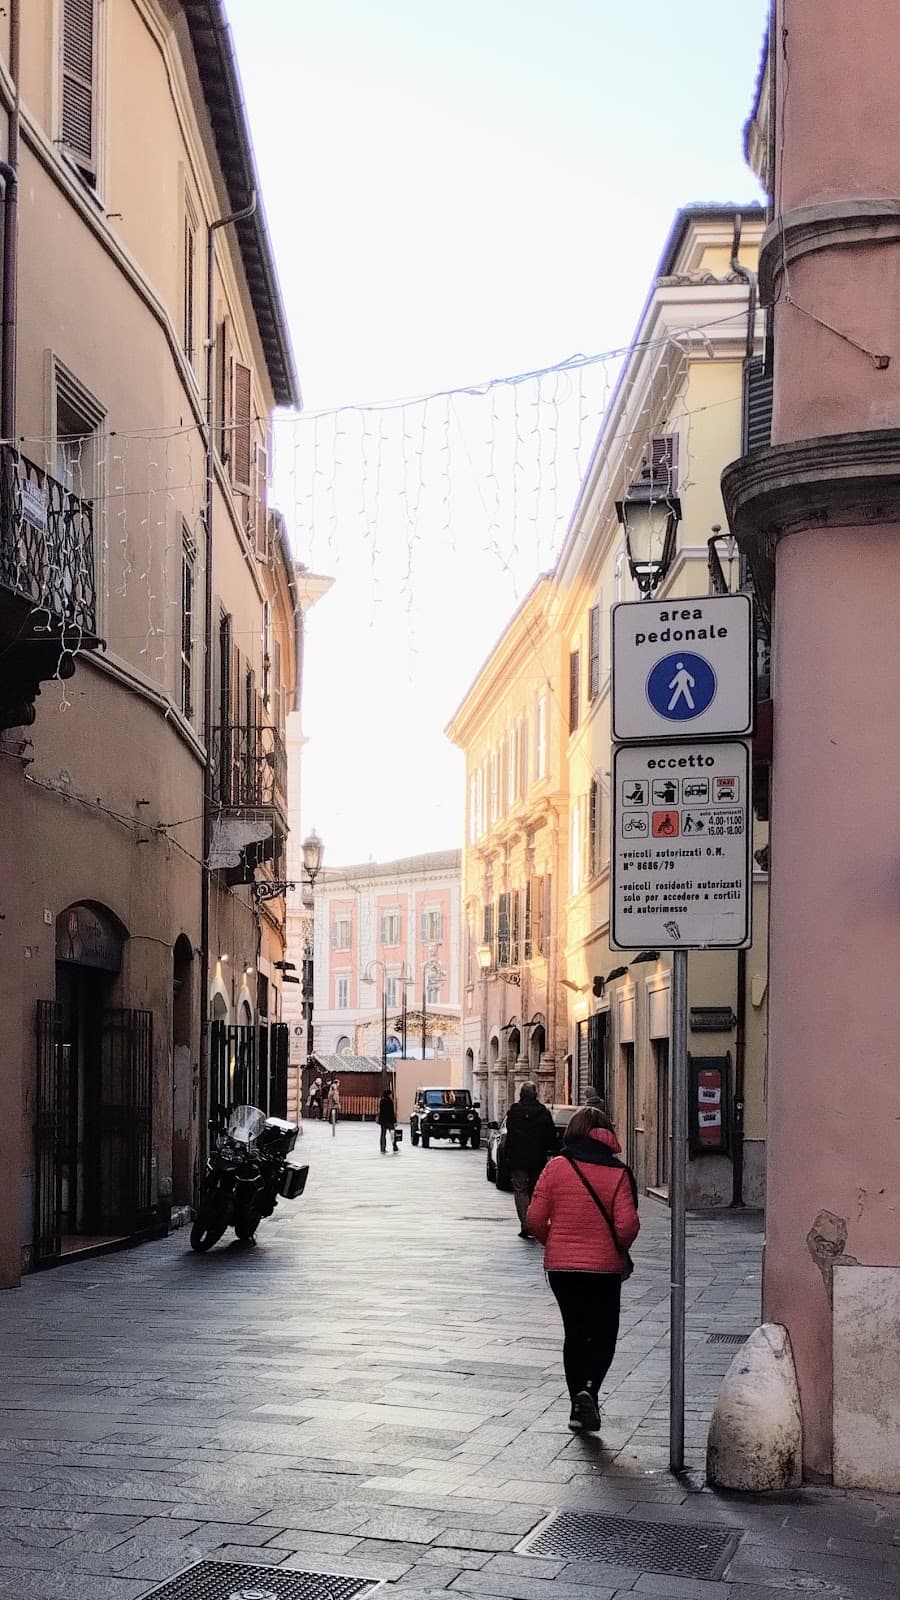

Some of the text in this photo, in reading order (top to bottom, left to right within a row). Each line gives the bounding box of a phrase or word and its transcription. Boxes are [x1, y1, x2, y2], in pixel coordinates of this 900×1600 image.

[659, 608, 703, 622] area
[635, 624, 728, 646] pedonale
[647, 754, 715, 768] eccetto
[656, 848, 702, 858] autorizzati
[706, 847, 725, 857] O.M.
[655, 880, 692, 890] residenti
[697, 879, 742, 889] autorizzati
[623, 892, 641, 902] solo
[645, 894, 659, 903] per
[663, 892, 700, 901] accedere
[713, 890, 741, 900] cortili
[623, 904, 688, 914] ed autorimesse
